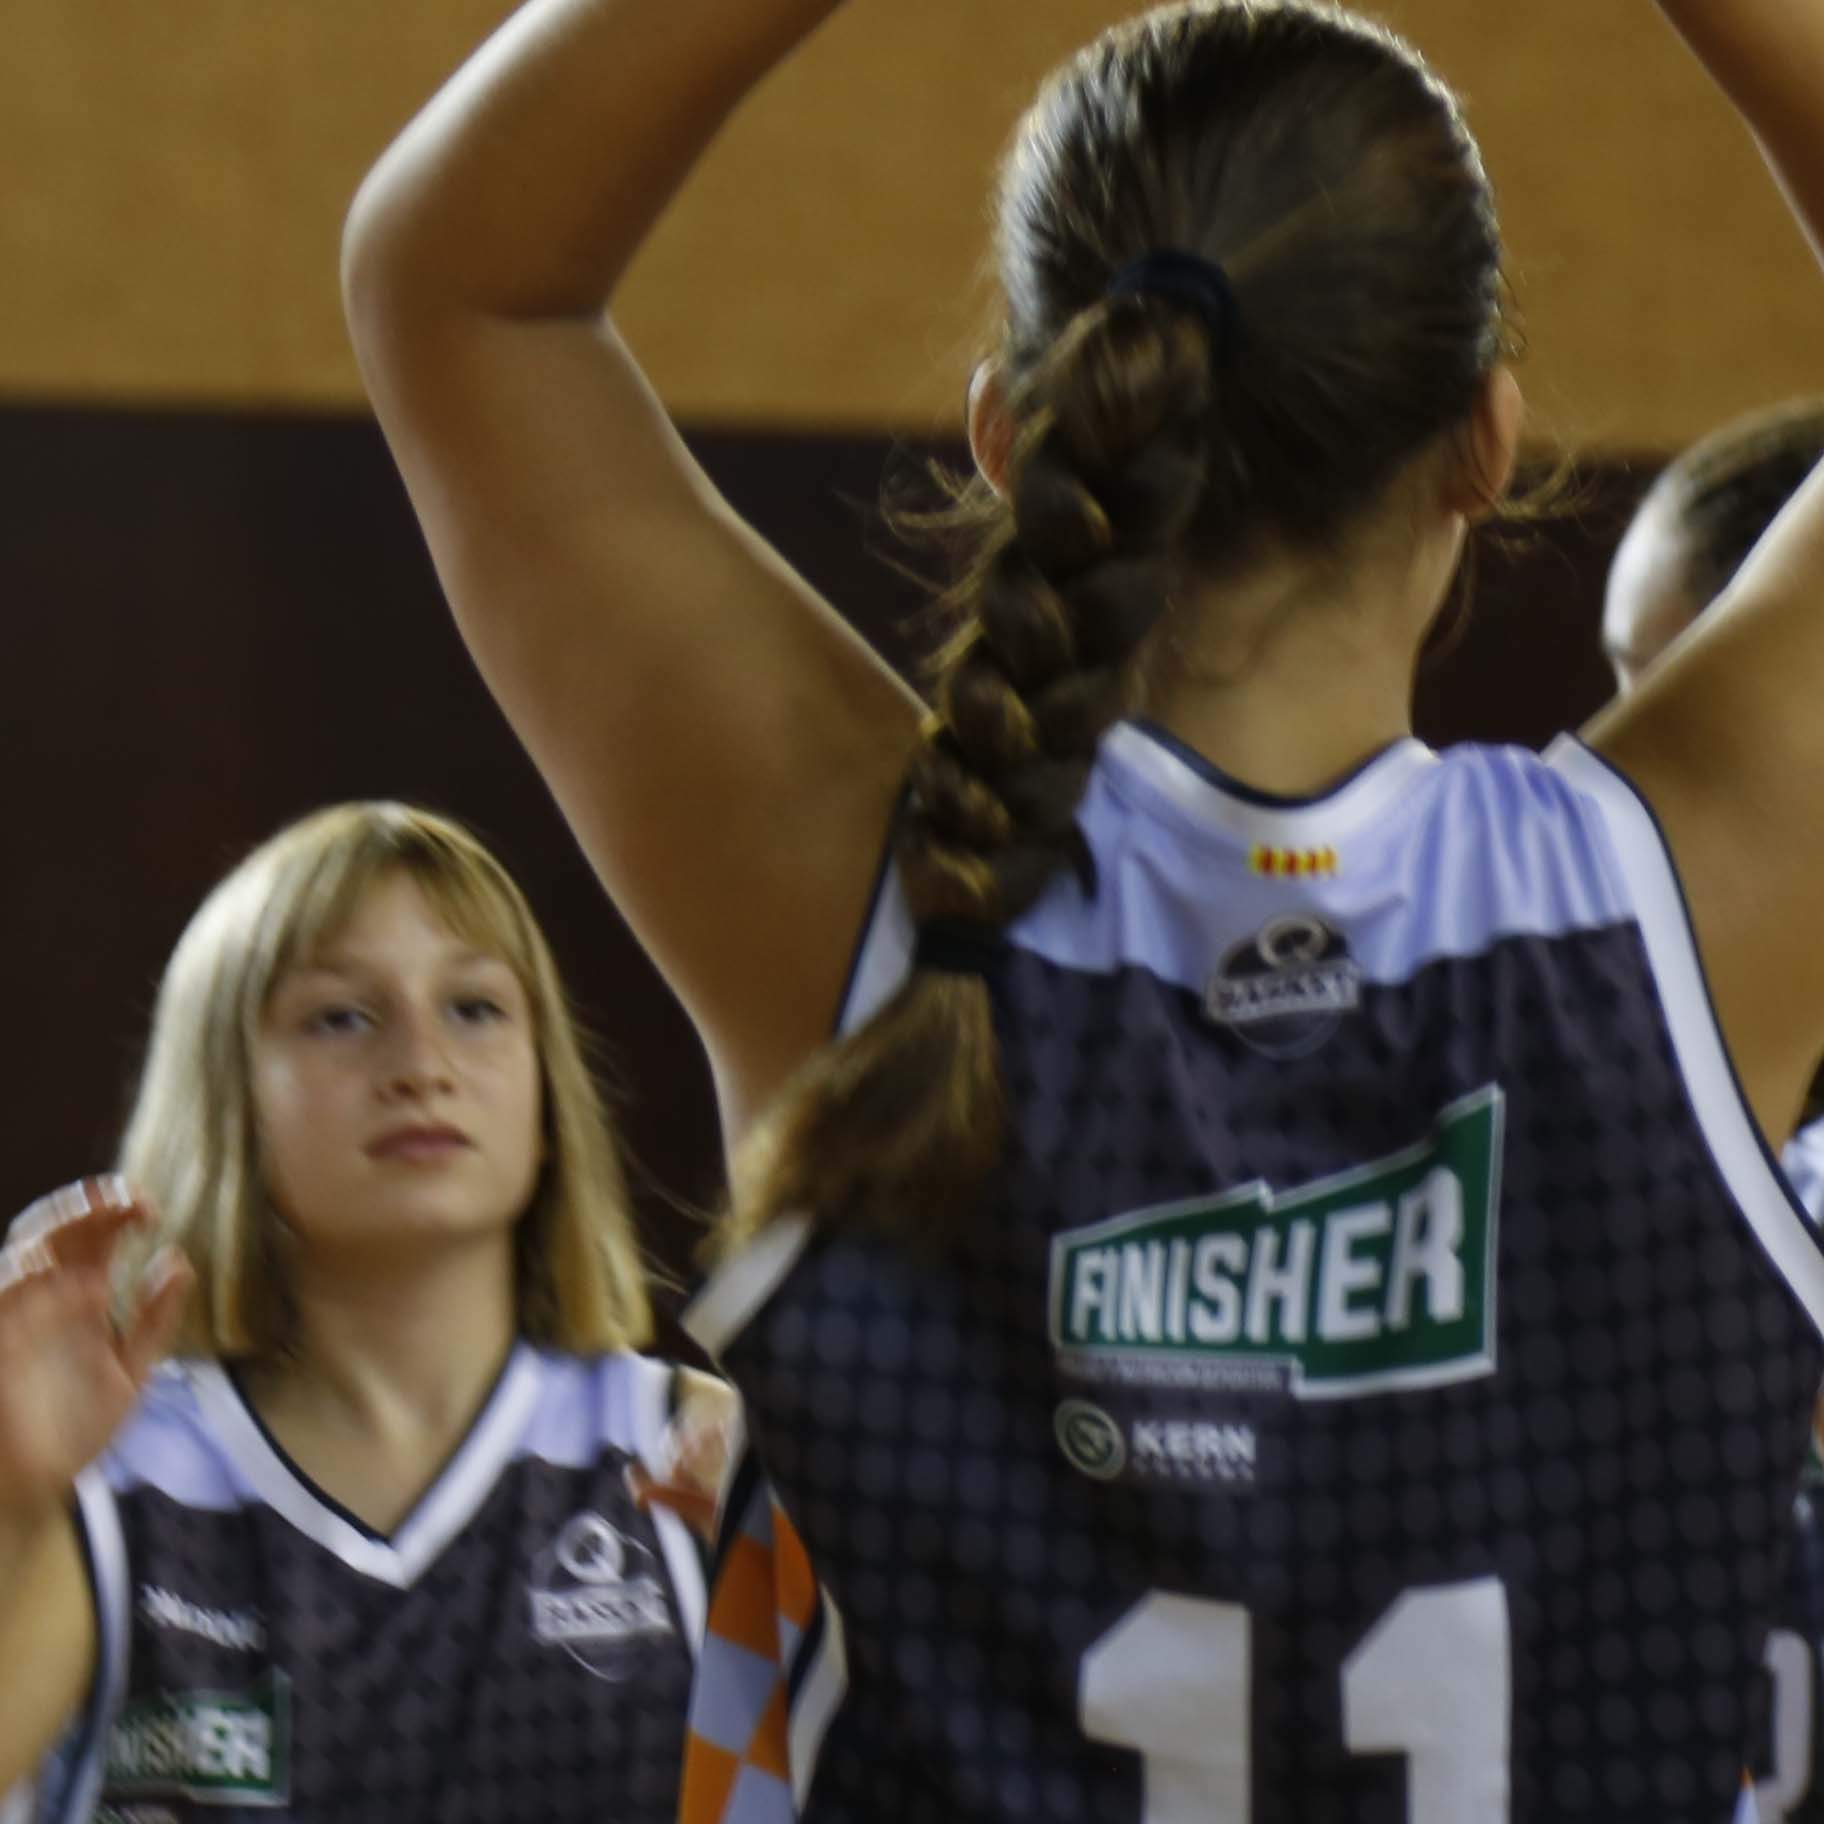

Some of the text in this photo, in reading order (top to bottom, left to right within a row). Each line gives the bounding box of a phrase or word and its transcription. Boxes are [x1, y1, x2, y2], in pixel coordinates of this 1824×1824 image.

[1069, 1165, 1467, 1345] FINISHER
[1131, 1420, 1256, 1463] KERN
[1079, 1576, 1512, 1824] 11
